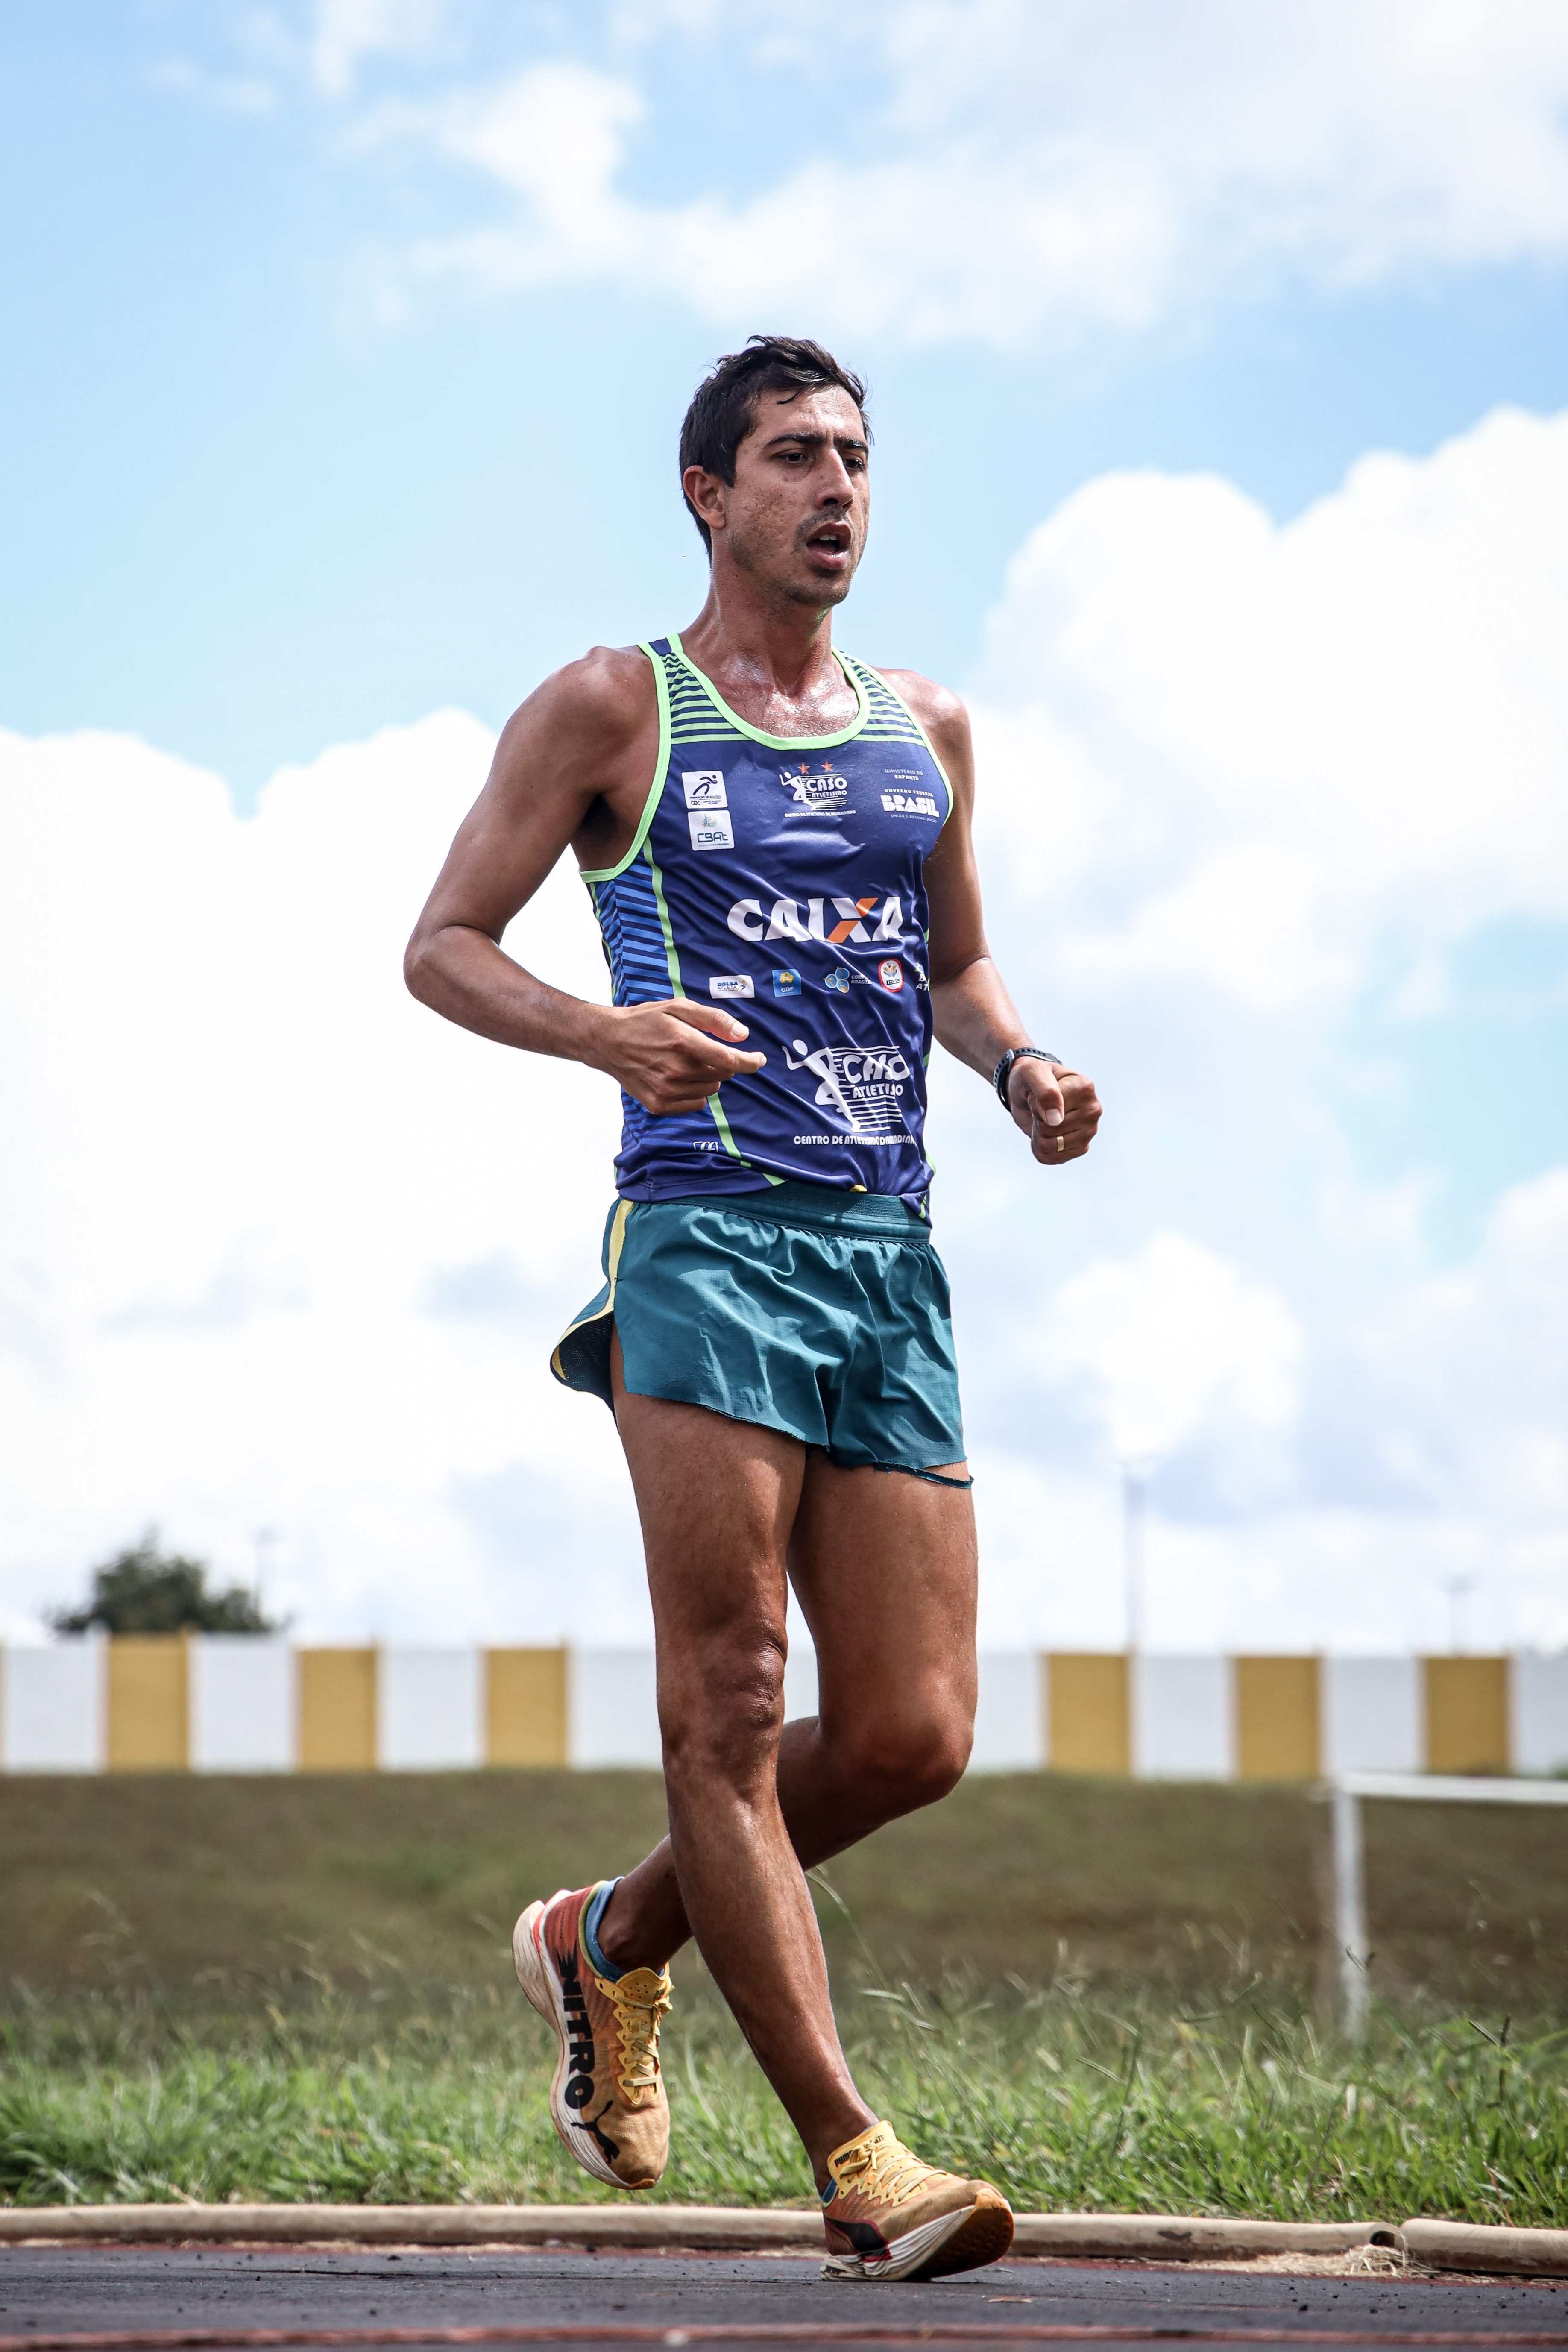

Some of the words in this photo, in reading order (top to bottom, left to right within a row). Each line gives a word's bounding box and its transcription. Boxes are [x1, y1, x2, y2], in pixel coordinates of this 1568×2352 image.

[806, 777, 847, 792] CASO
[880, 795, 940, 818] BRASIL
[909, 815, 937, 823] RECONSTRUÇÃO
[727, 896, 904, 943] CAIXA
[843, 1054, 910, 1084] CASO
[793, 1135, 829, 1145] CENTRO
[832, 1135, 843, 1144] DE
[556, 1941, 595, 2109] NITRO
